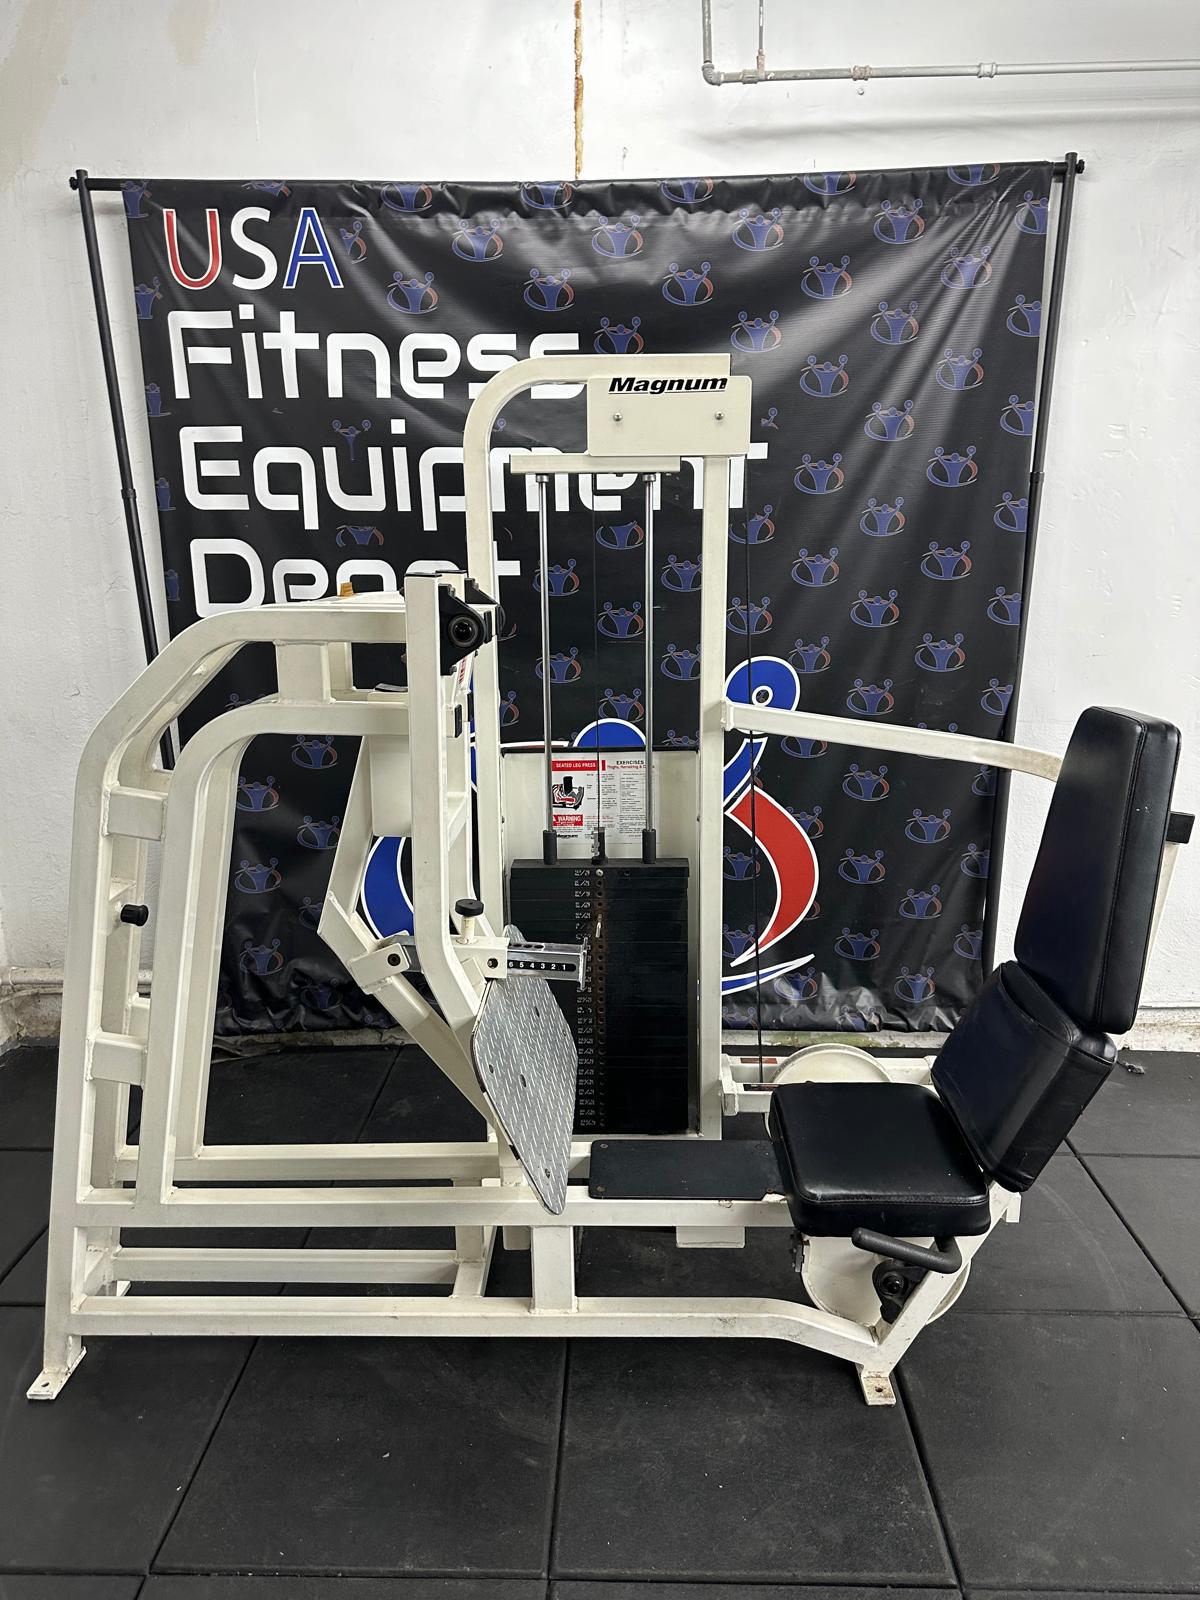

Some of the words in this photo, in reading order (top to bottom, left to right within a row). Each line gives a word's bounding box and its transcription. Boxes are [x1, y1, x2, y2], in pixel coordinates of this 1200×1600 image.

[162, 206, 344, 291] USA
[166, 303, 587, 400] Fitness
[609, 377, 728, 394] Magnum
[190, 538, 520, 618] Dep
